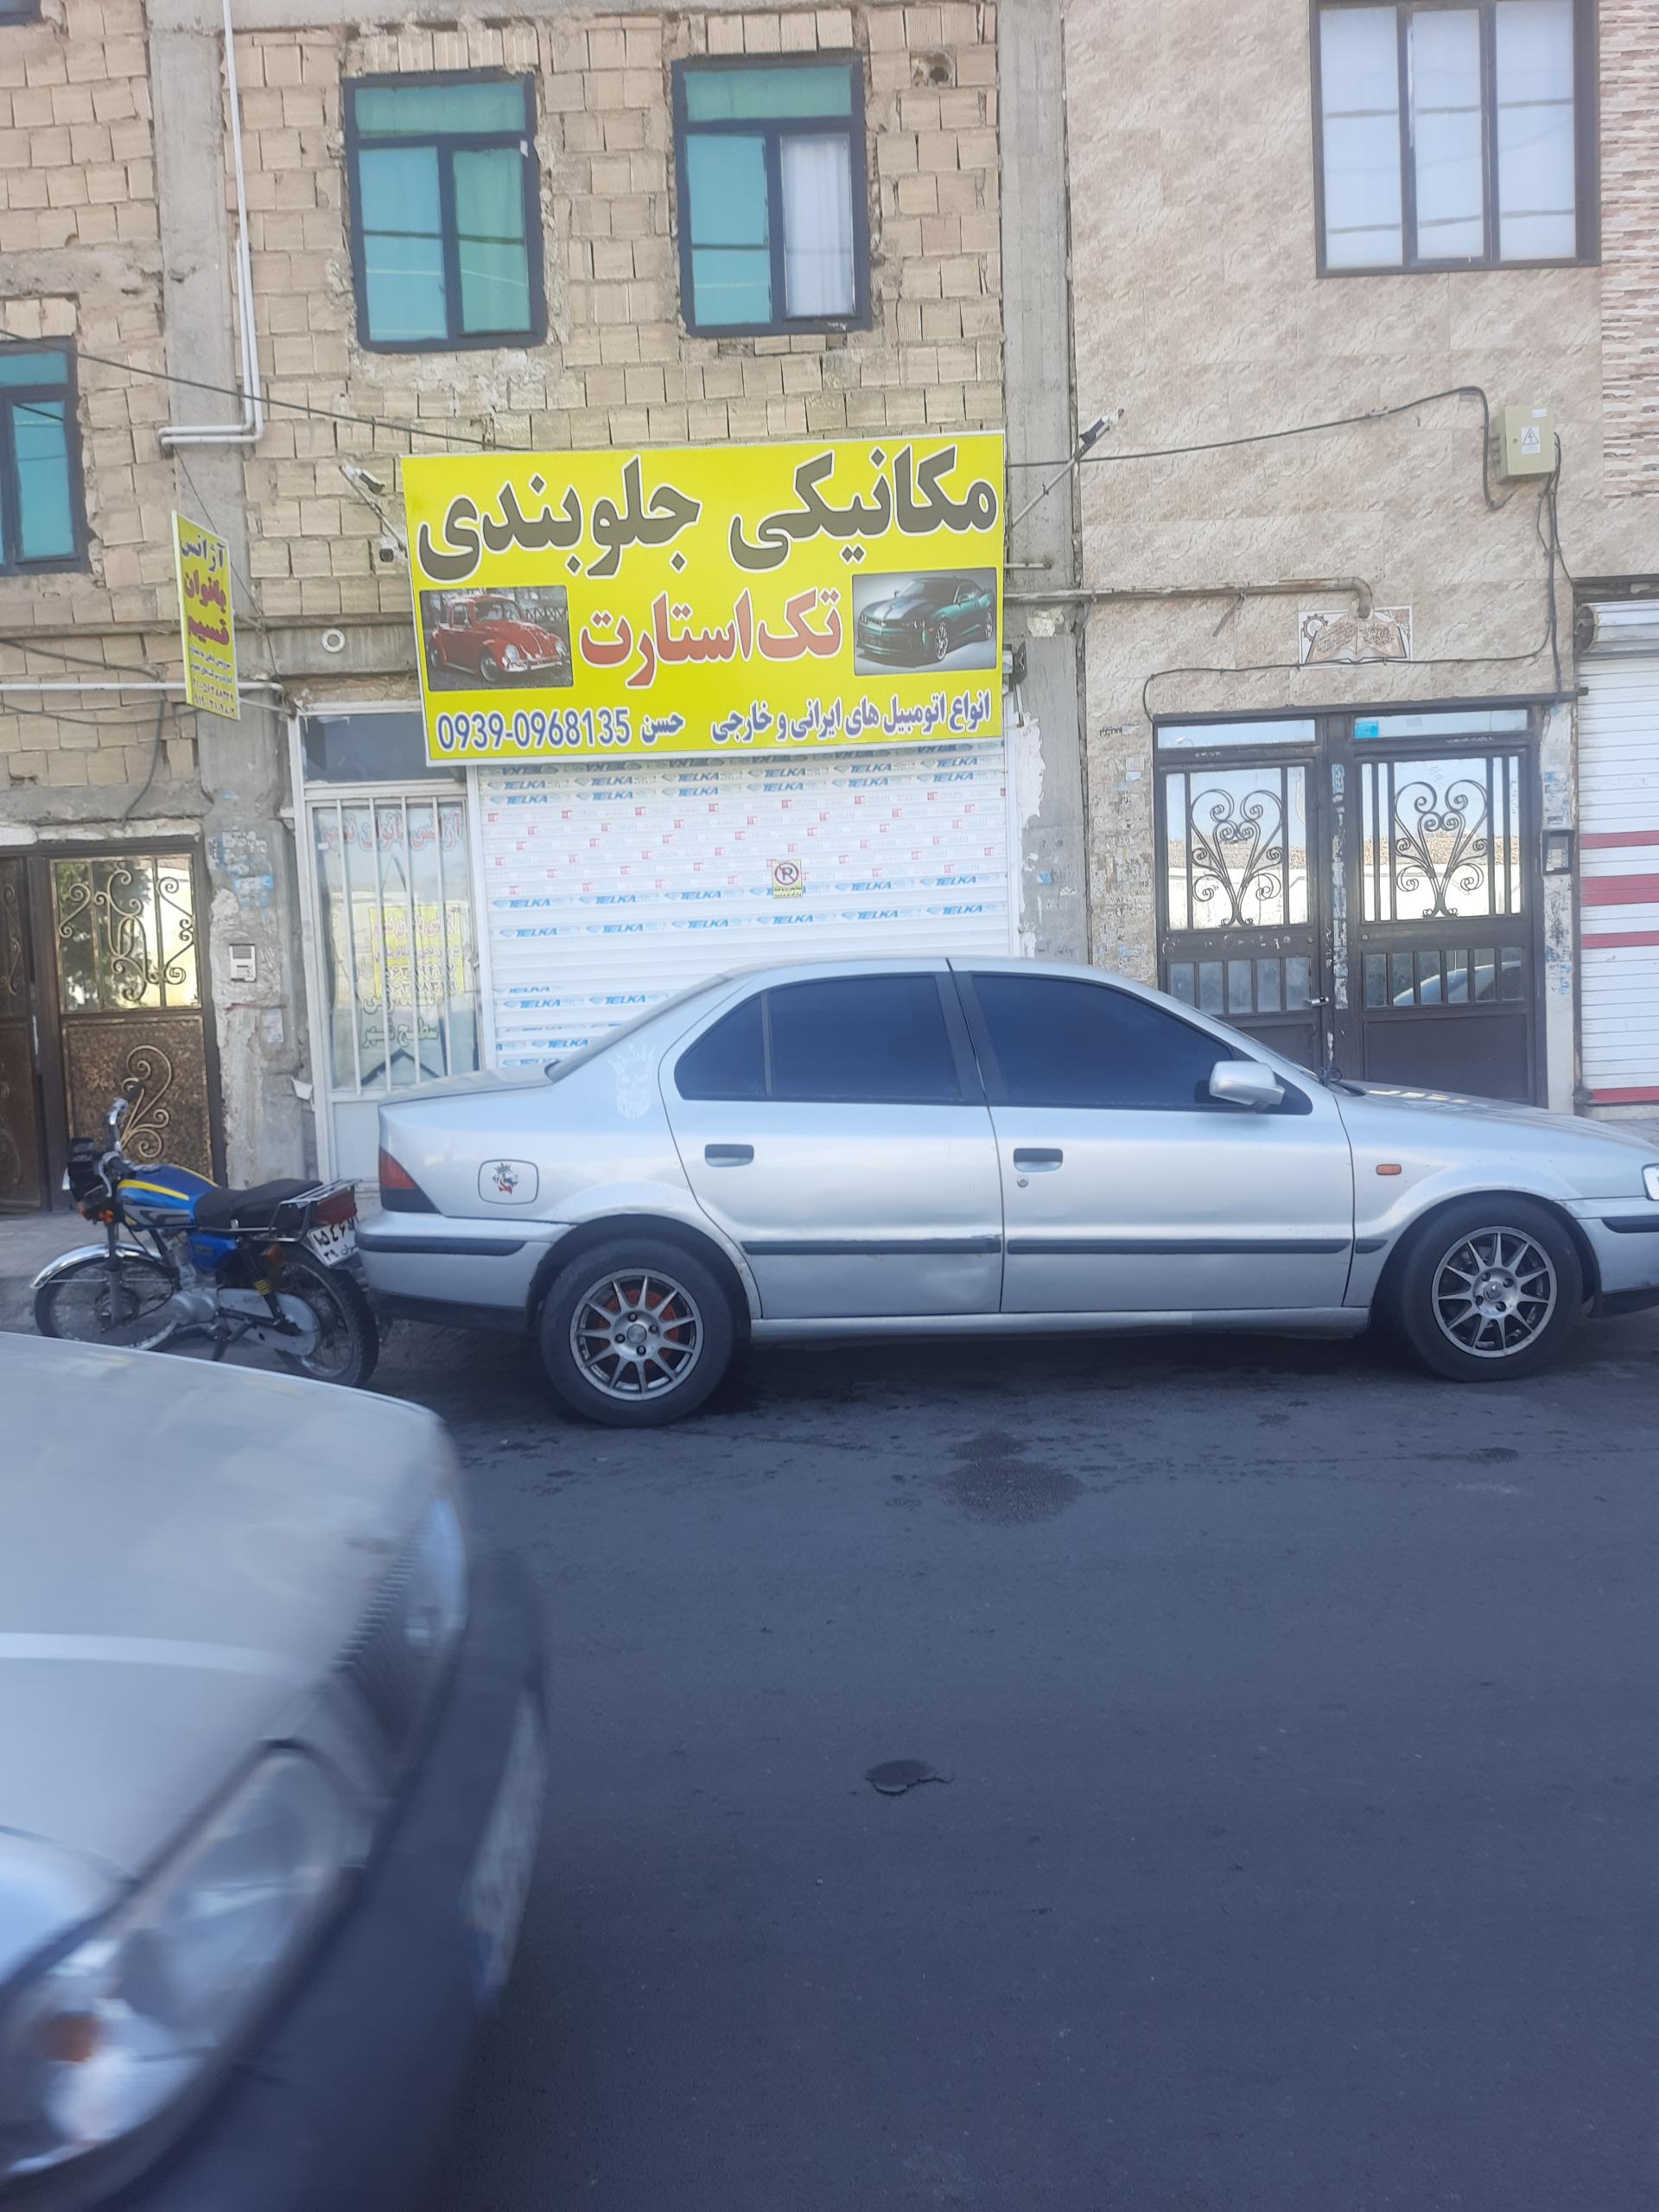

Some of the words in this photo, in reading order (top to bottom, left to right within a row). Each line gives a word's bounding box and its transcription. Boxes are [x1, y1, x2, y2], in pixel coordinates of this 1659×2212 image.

[419, 457, 701, 580] جلوبندی
[728, 445, 998, 569] مکانیکی
[181, 535, 226, 572] آژانس
[184, 569, 227, 614] بانوان
[581, 590, 753, 688] استارت
[756, 589, 842, 659] تک
[437, 708, 630, 750] 0939-0968135
[640, 713, 684, 746] حسن
[711, 699, 773, 743] خارجی
[777, 712, 787, 741] و
[791, 696, 842, 741] ایرانی
[845, 695, 880, 734] های
[883, 692, 946, 733] اتومبیل
[950, 690, 990, 731] انواع
[505, 780, 546, 790] TELKA
[591, 776, 632, 786] TELKA
[677, 772, 719, 782] TELKA
[764, 767, 805, 778] TELKA
[850, 763, 892, 773] TELKA
[937, 756, 978, 767] TELKA
[506, 794, 548, 804] TELKA
[593, 791, 632, 801] TELKA
[678, 787, 718, 797] TELKA
[763, 782, 804, 792] TELKA
[848, 777, 888, 787] TELKA
[932, 772, 973, 782] TELKA
[510, 899, 550, 907] TELKA
[595, 894, 636, 904] TELKA
[681, 890, 721, 899] TELKA
[851, 881, 891, 891] TELKA
[936, 876, 976, 886] TELKA
[516, 927, 556, 937] TELKA
[602, 923, 643, 933] TELKA
[688, 919, 728, 929] TELKA
[772, 914, 813, 924] TELKA
[857, 910, 899, 919] TELKA
[943, 905, 982, 914] TELKA
[519, 999, 560, 1008] TELKA
[605, 995, 645, 1004] TELKA
[548, 1039, 588, 1048] TELKA
